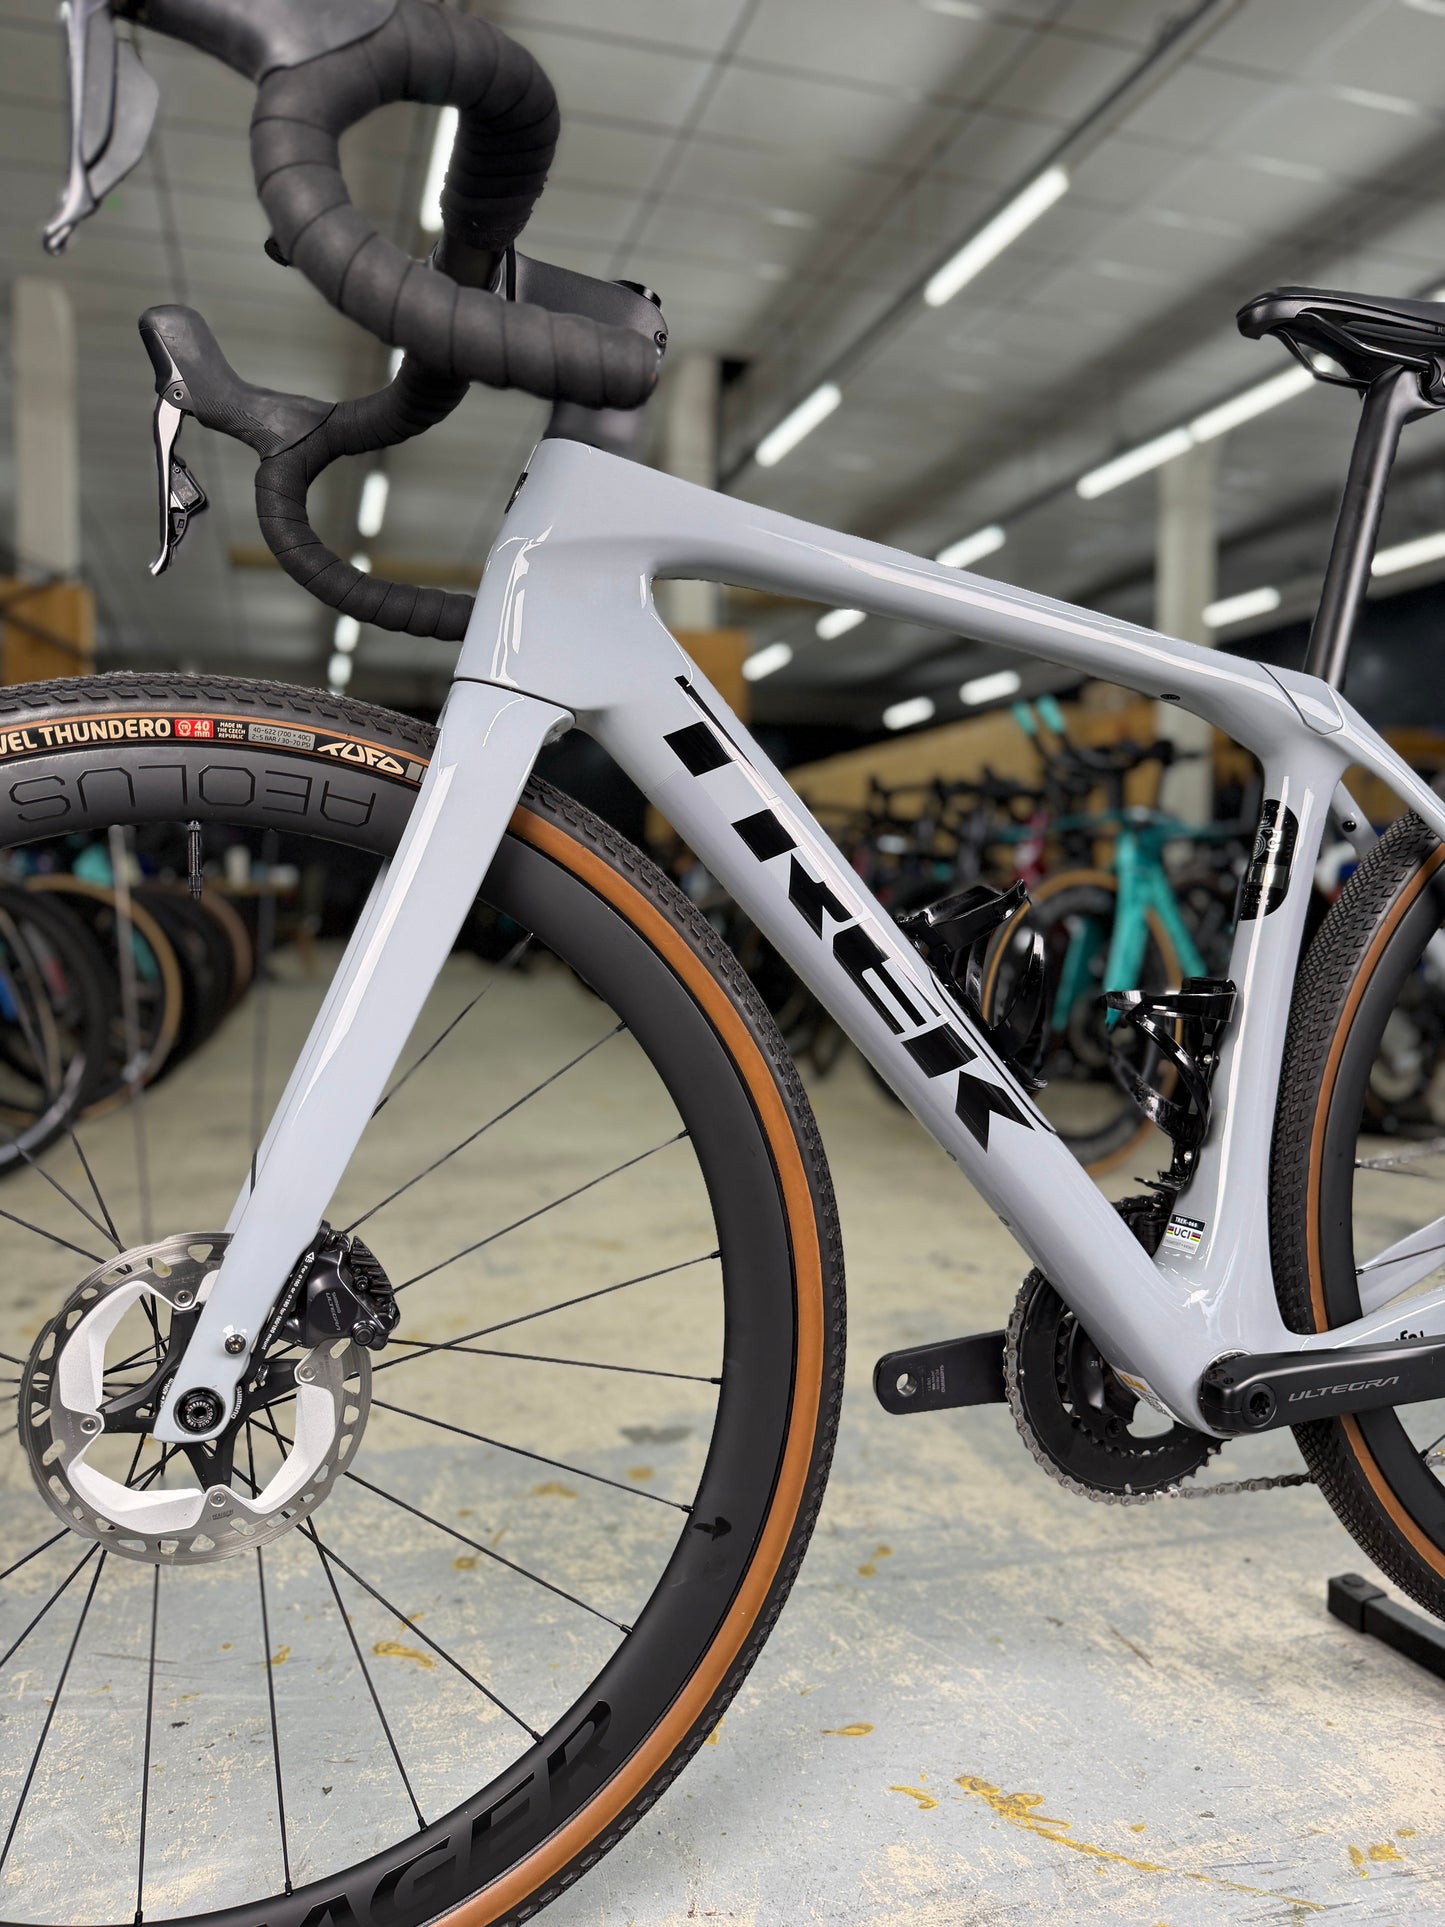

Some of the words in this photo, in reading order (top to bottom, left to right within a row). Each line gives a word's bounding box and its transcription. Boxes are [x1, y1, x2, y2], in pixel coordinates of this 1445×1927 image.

[39, 718, 171, 746] THUNDERO
[194, 720, 210, 731] 40
[317, 742, 405, 775] TUFO
[8, 764, 377, 829] AEOLUS
[662, 675, 1036, 1153] TREK
[1173, 1227, 1191, 1239] UCI
[300, 1265, 308, 1274] For
[325, 1292, 341, 1331] ULTEGRA
[1288, 1375, 1400, 1402] ULTEGRA
